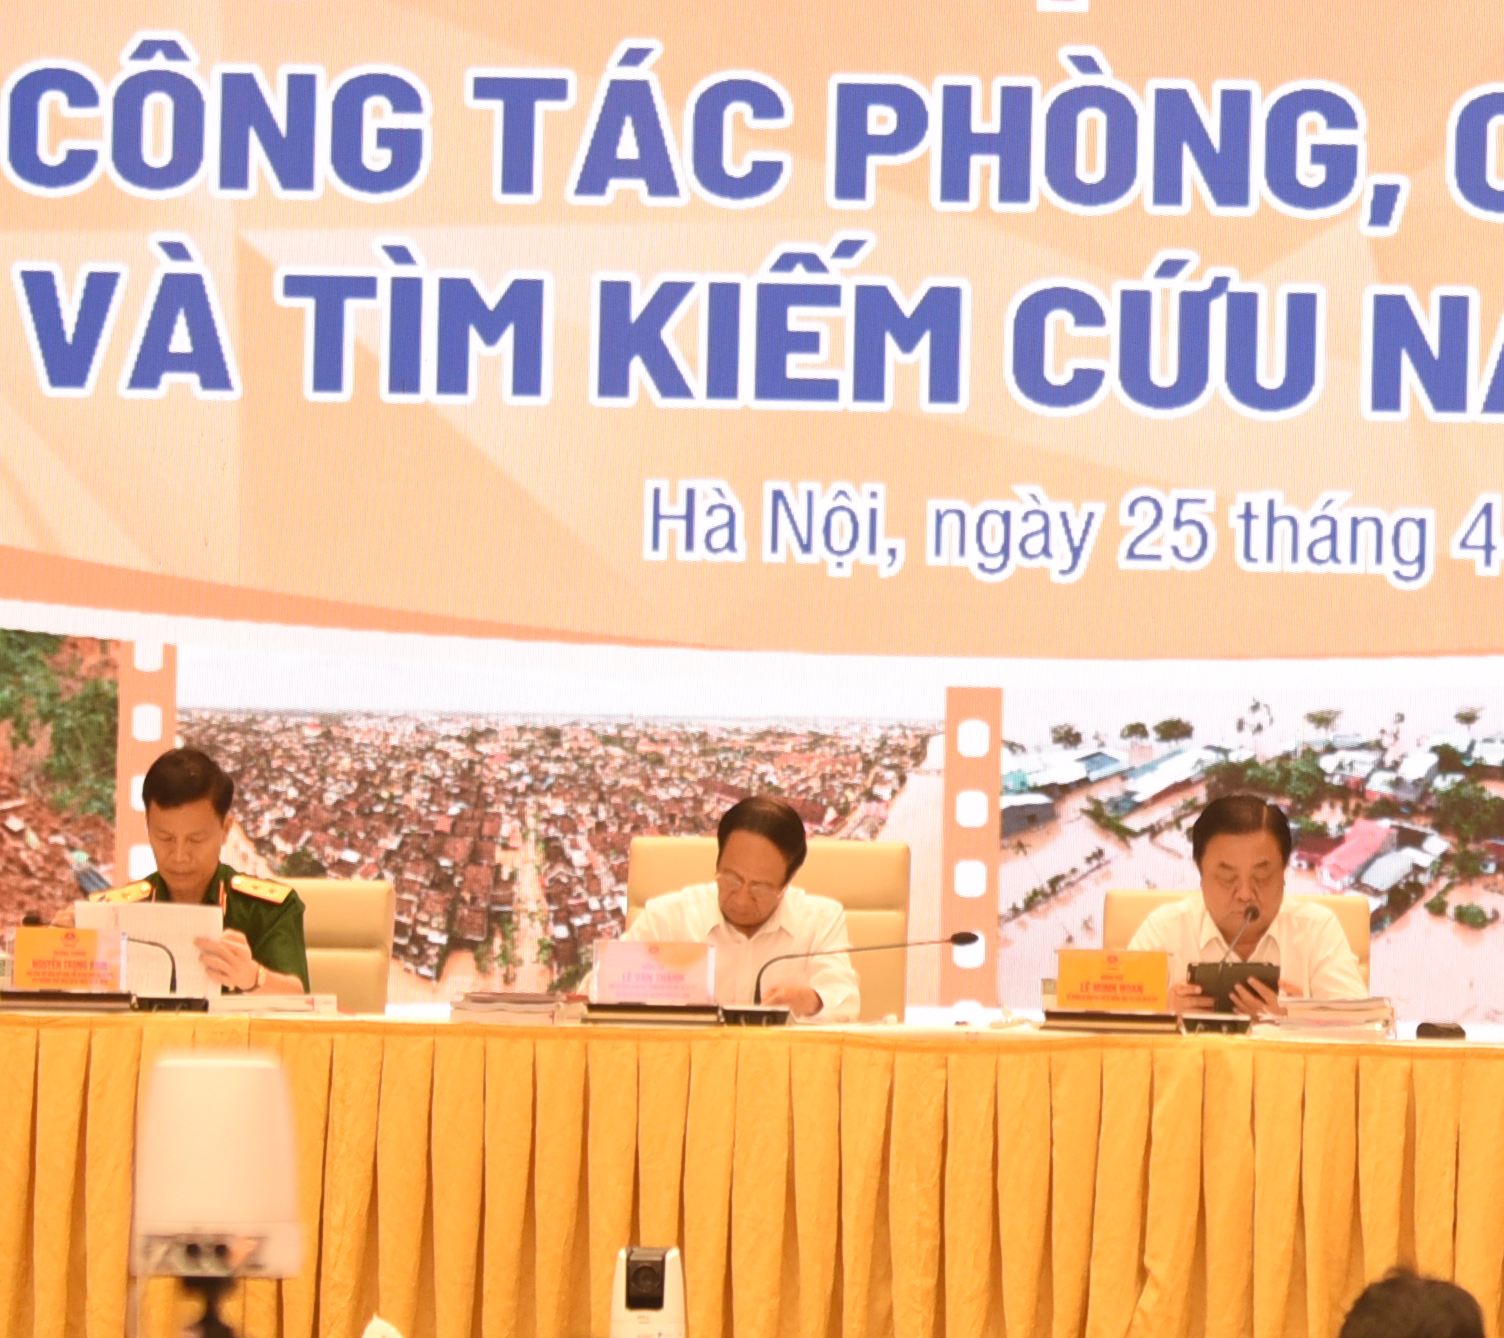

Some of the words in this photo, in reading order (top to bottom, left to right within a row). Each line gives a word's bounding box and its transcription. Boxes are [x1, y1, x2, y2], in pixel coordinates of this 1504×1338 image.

[8, 39, 423, 194] CÔNG
[473, 47, 785, 200] TÁC
[834, 55, 1401, 227] PHÒNG,
[20, 241, 232, 391] VÀ
[283, 245, 544, 396] TÌM
[597, 239, 961, 404] KIẾM
[1012, 259, 1317, 412] CỨU
[651, 486, 738, 555] Hà
[769, 488, 898, 569] Nội,
[933, 495, 1096, 577] ngày
[1124, 494, 1209, 564] 25
[1236, 497, 1428, 583] tháng
[1458, 501, 1497, 568] 4
